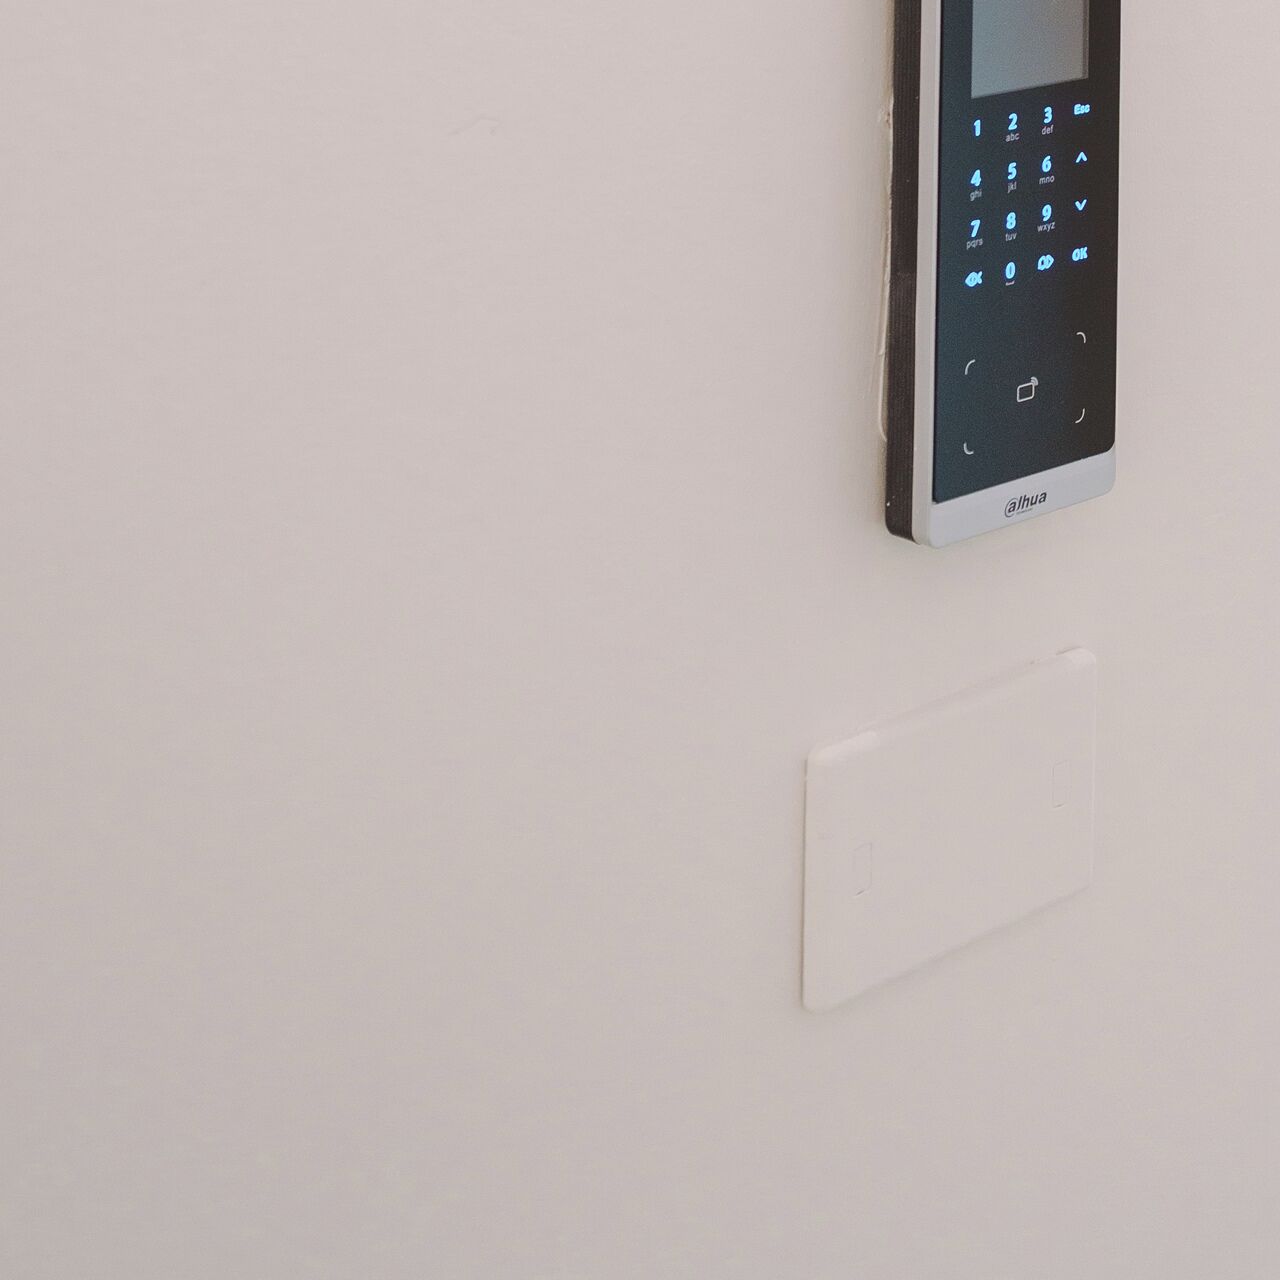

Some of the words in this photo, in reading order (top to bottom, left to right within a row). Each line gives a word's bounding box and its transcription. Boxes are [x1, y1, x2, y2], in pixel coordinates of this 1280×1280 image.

[1043, 106, 1053, 123] 3
[1074, 103, 1090, 115] Esc
[974, 120, 981, 136] 1
[1008, 113, 1018, 131] 2
[1041, 125, 1054, 135] def
[1006, 132, 1020, 142] abc
[1008, 162, 1017, 180] 5
[1042, 156, 1051, 172] 6
[970, 169, 981, 186] 4
[1039, 175, 1055, 185] mno
[1006, 212, 1016, 229] 8
[1042, 204, 1052, 221] 9
[970, 219, 981, 237] 7
[1037, 221, 1055, 232] wxyz
[1072, 246, 1088, 262] OK
[1005, 262, 1016, 279] 0
